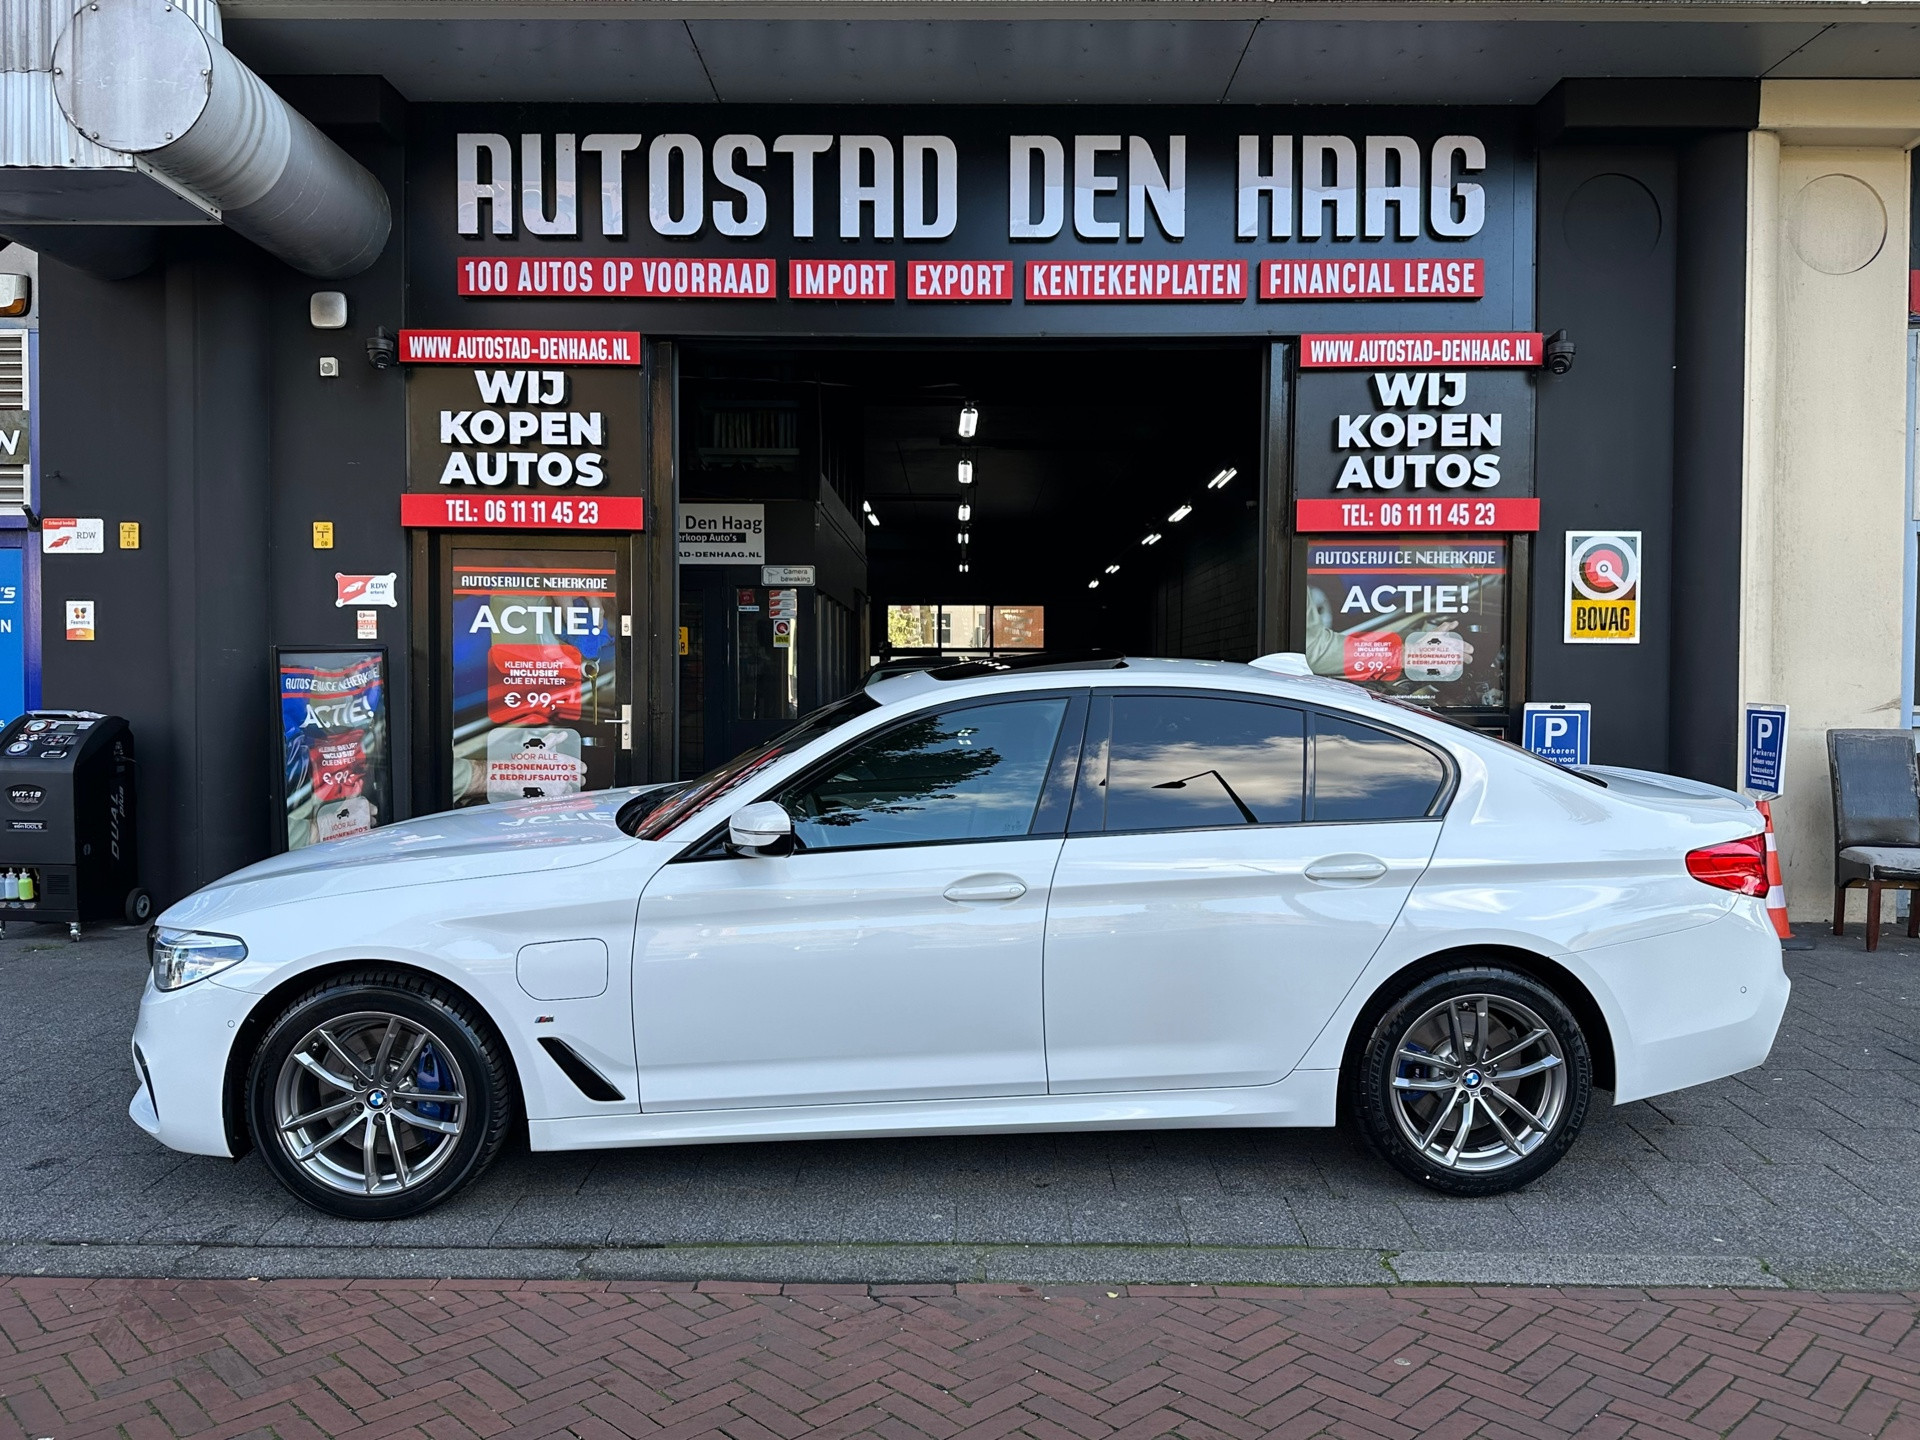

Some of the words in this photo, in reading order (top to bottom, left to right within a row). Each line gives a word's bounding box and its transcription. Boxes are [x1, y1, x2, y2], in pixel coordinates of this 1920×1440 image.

[457, 132, 958, 239] AUTOSTAD
[1009, 134, 1186, 239] DEN
[1237, 134, 1486, 239] HAAG
[465, 261, 508, 293] 100
[517, 261, 593, 293] AUTOS
[602, 261, 635, 294] OP
[641, 262, 770, 295] VOORRAAD
[795, 263, 888, 296] IMPORT
[915, 263, 1006, 296] EXPORT
[1033, 263, 1241, 296] KENTEKENPLATEN
[1270, 262, 1395, 295] FINANCIAL
[1404, 262, 1475, 293] LEASE
[409, 336, 631, 361] WWW.AUTOSTAD-DENHAAG.NL
[1310, 338, 1533, 363] WWW.AUTOSTAD-DENHAAG.NL
[474, 370, 565, 405] WIJ
[1374, 372, 1467, 407] WIJ
[440, 410, 602, 446] KOPEN
[1338, 412, 1502, 448] KOPEN
[439, 451, 604, 487] AUTOS
[1336, 453, 1501, 489] AUTOS
[446, 500, 478, 522] TEL:
[484, 500, 506, 523] 06
[511, 500, 526, 523] 11
[531, 500, 546, 523] 11
[551, 501, 573, 524] 45
[578, 502, 599, 524] 23
[686, 515, 718, 530] Den
[722, 515, 763, 534] Haag
[1342, 504, 1374, 526] TEL:
[1380, 504, 1401, 526] 06
[1407, 504, 1422, 526] 11
[1427, 503, 1442, 526] 11
[1447, 503, 1470, 526] 45
[1474, 502, 1496, 526] 23
[76, 532, 97, 540] RDW
[709, 534, 737, 542] Auto's
[1315, 551, 1412, 565] AUTOSERVICE
[1415, 550, 1496, 565] NEHERKADE
[461, 576, 540, 588] AUTOSERVICE
[543, 578, 608, 590] NEHERKADE
[780, 576, 811, 584] bewaking
[1340, 585, 1470, 614] ACTIE!
[469, 605, 601, 636] ACTIE!
[1576, 606, 1630, 632] BOVAG
[1354, 661, 1364, 672] €
[1368, 661, 1392, 673] 99,-
[538, 678, 566, 686] FILTER
[299, 696, 374, 728] ACTIE!
[504, 692, 522, 708] €
[527, 692, 565, 710] 99,-
[1545, 718, 1568, 748] P
[1758, 718, 1773, 748] P
[1752, 748, 1776, 758] Parkeren
[322, 772, 334, 785] €
[499, 774, 578, 782] BEDRIJFSAUTO'S
[111, 794, 119, 860] DUAL
